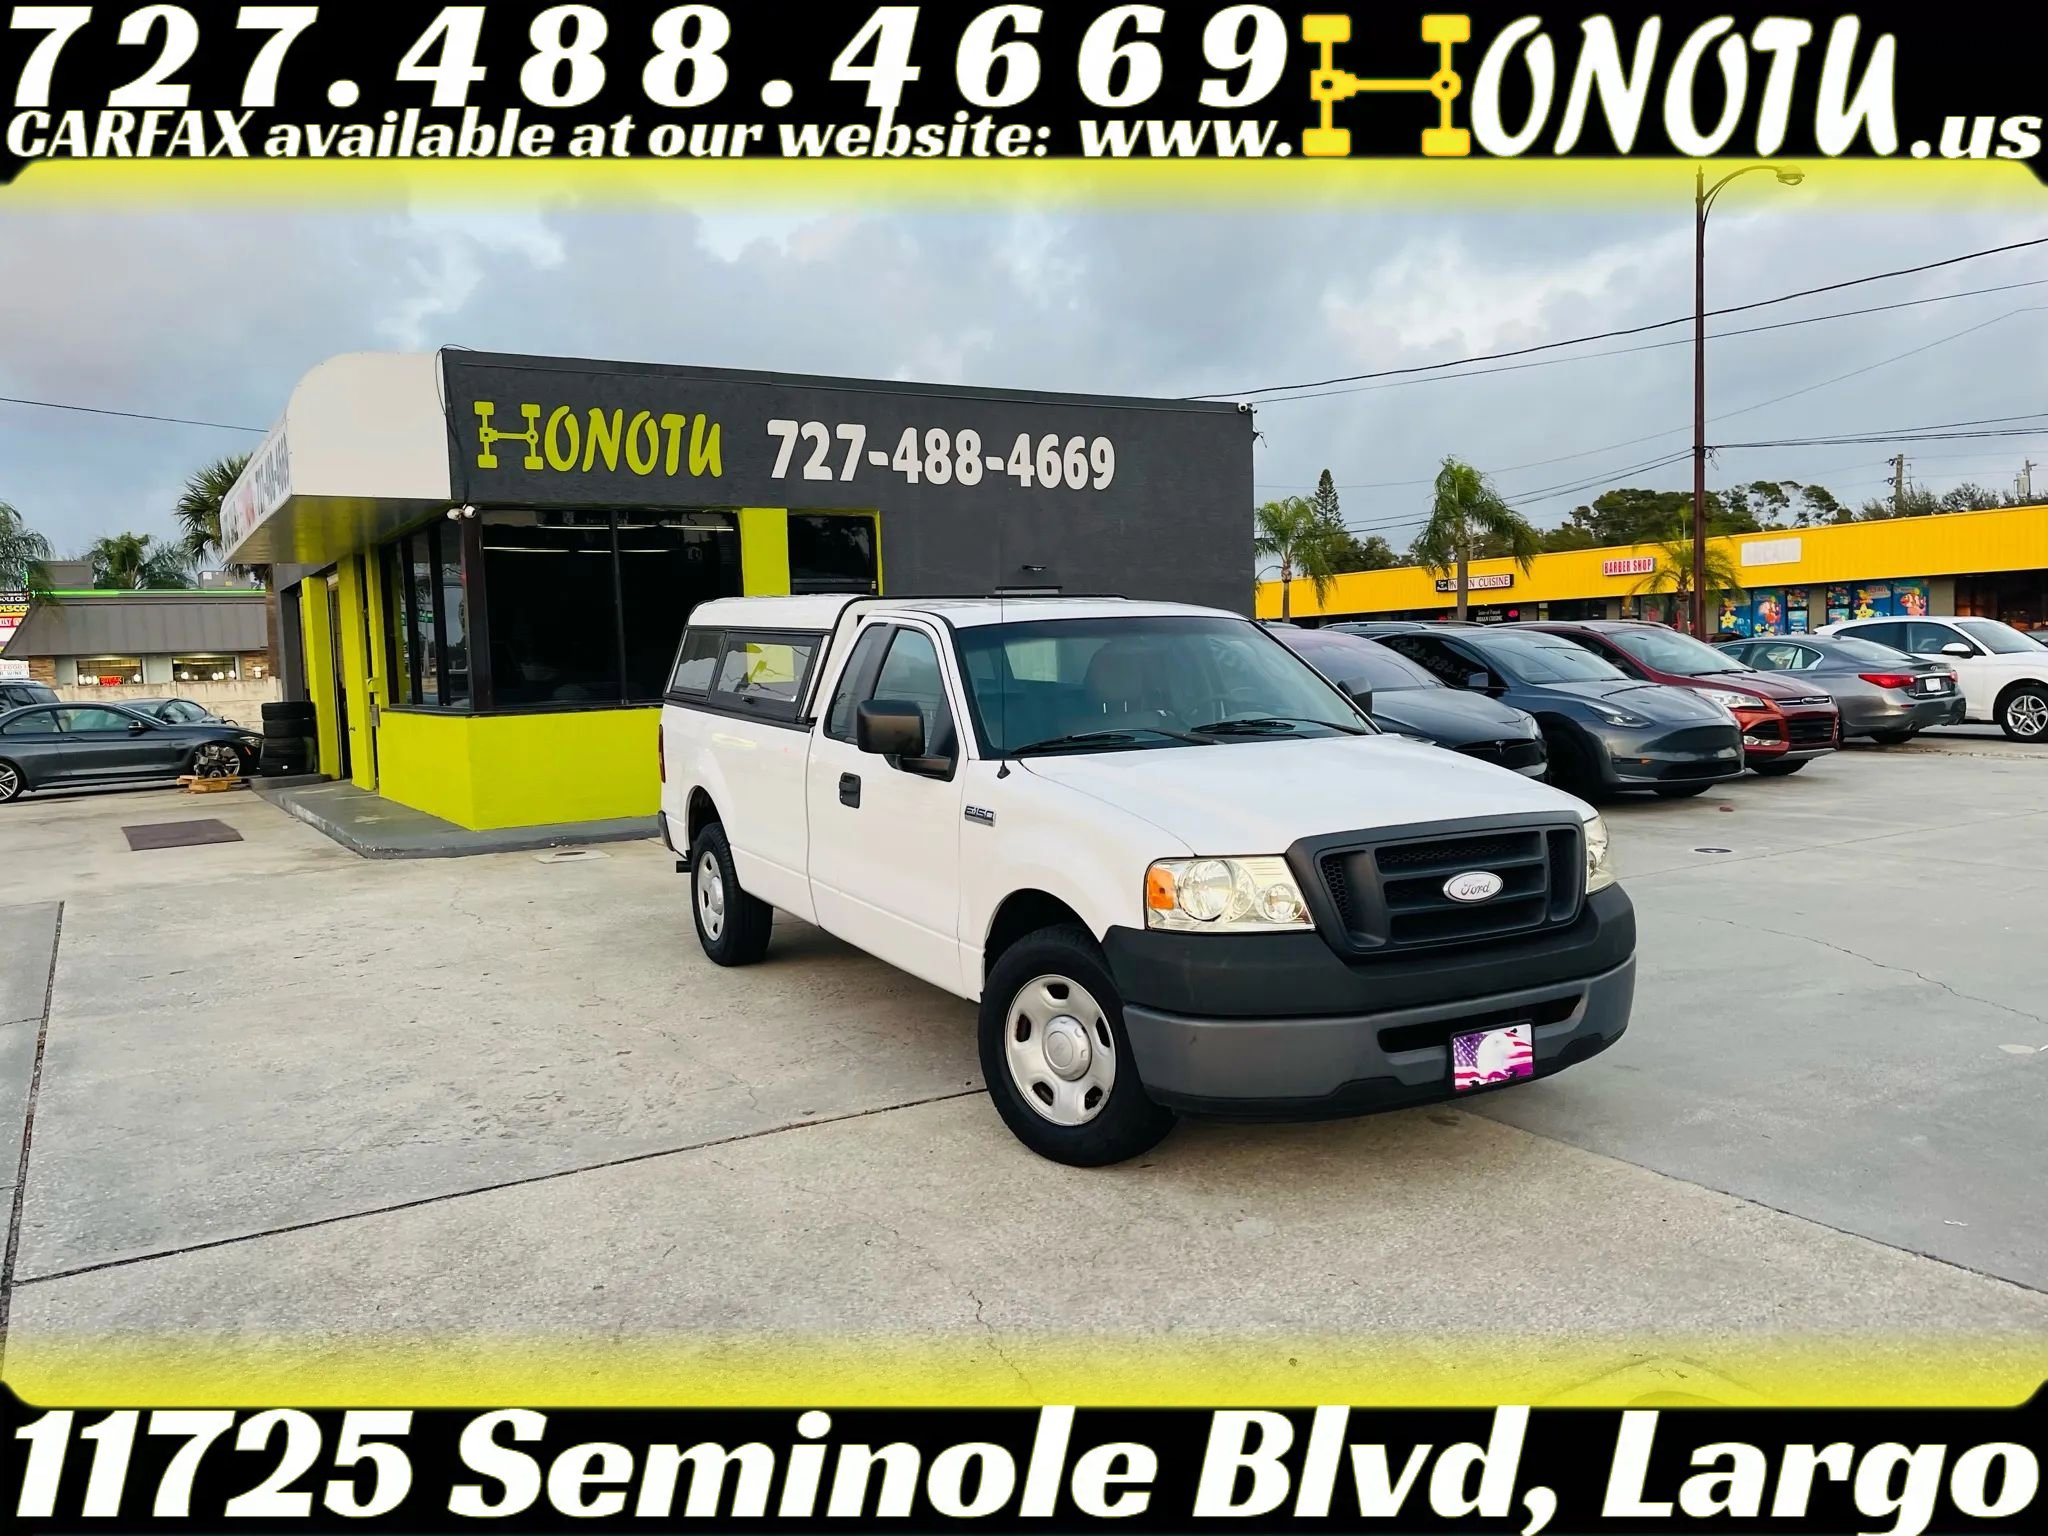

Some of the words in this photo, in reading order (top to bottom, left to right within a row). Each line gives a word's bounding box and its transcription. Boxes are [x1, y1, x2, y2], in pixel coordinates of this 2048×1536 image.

[767, 419, 1116, 490] 727-488-4669
[1604, 560, 1631, 574] BARBER
[1633, 558, 1651, 572] SHOP
[1478, 575, 1509, 588] CUISINE
[1461, 881, 1491, 896] Ford
